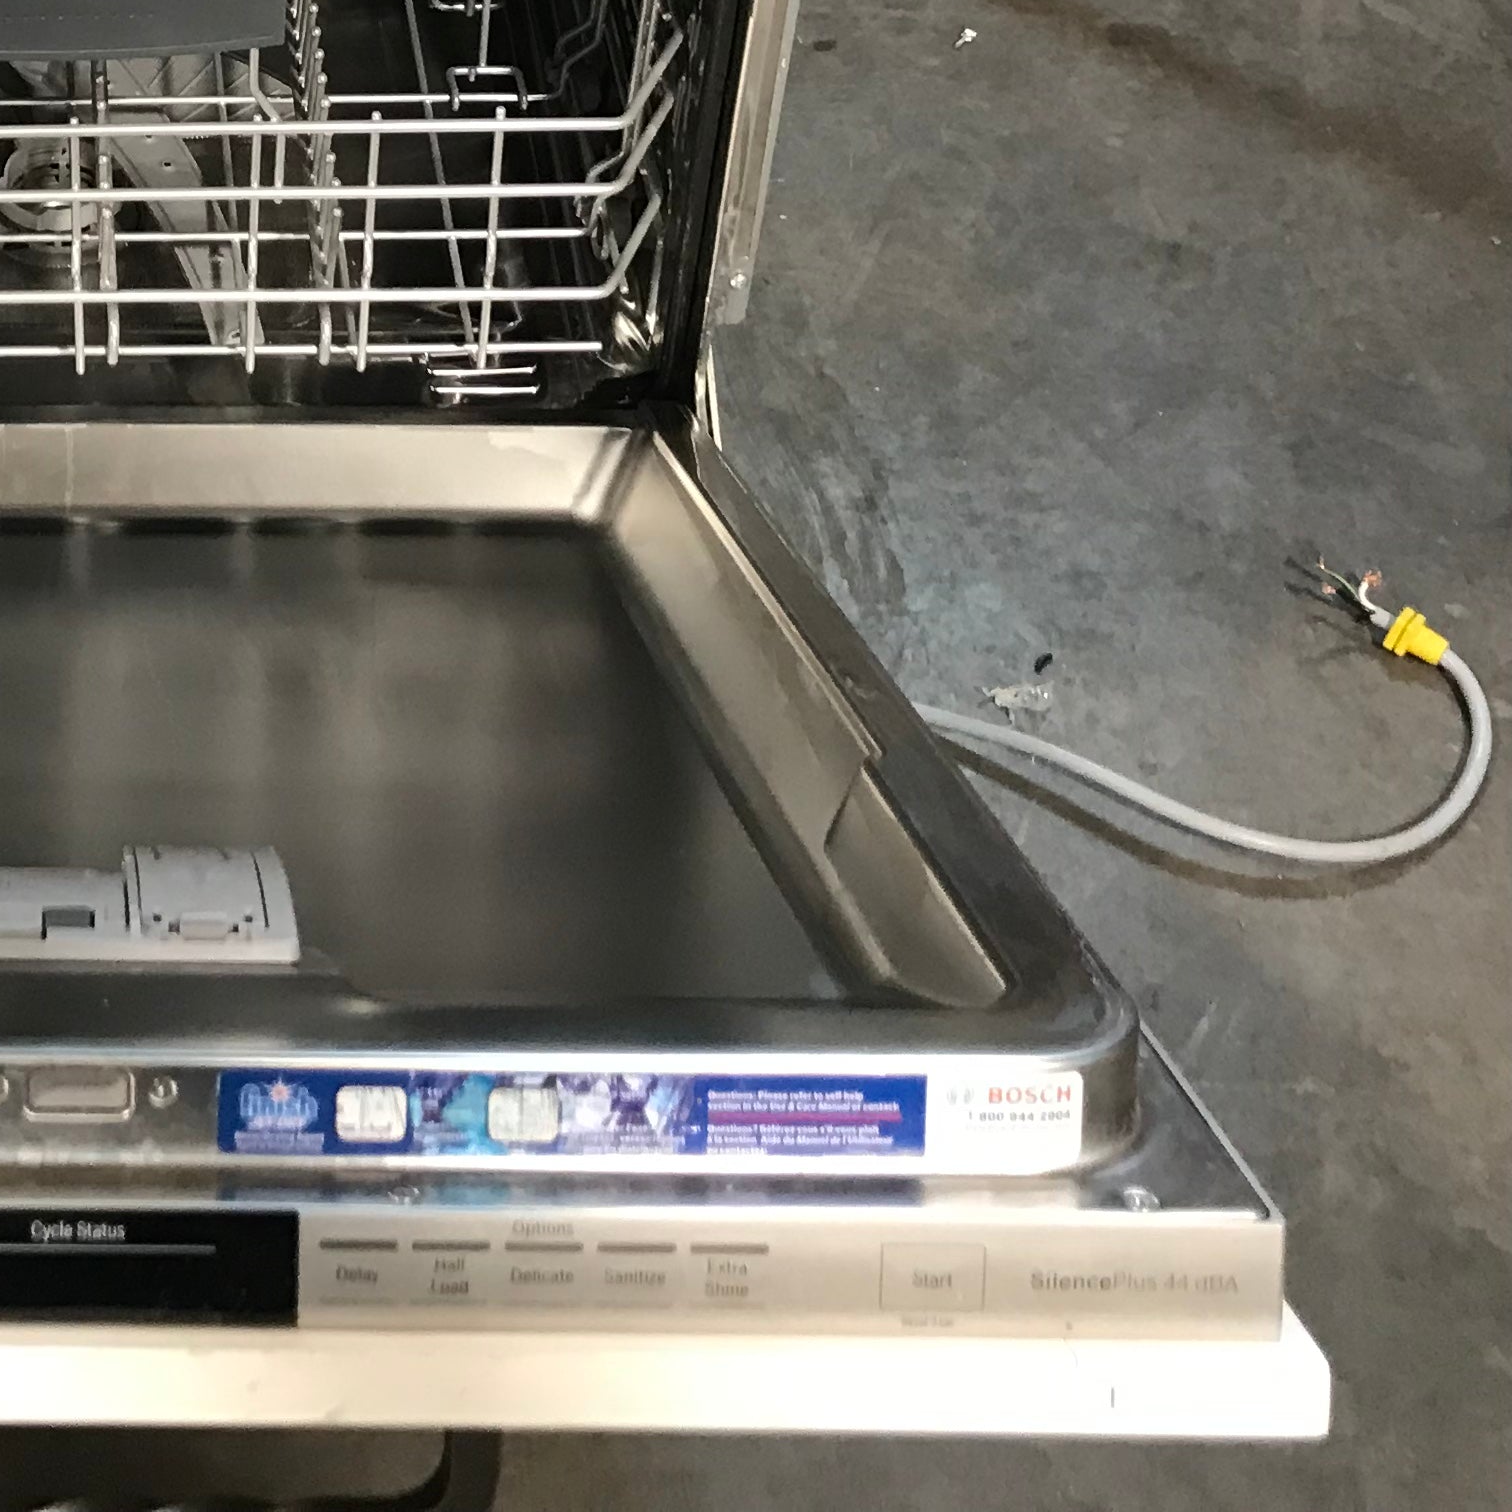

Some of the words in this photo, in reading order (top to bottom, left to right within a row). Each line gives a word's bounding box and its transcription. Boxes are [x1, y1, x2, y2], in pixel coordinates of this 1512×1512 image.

[988, 1085, 1071, 1104] BOSCH
[31, 1219, 73, 1243] Cycle
[77, 1220, 126, 1240] Status
[512, 1220, 575, 1237] Options
[336, 1265, 378, 1285] Delay
[707, 1257, 748, 1275] Extra
[510, 1267, 575, 1284] Delicate
[604, 1268, 666, 1285] Sanitize
[911, 1270, 952, 1288] Start
[1031, 1269, 1158, 1291] SilencePlus
[430, 1279, 469, 1295] Load
[705, 1281, 749, 1297] Shine
